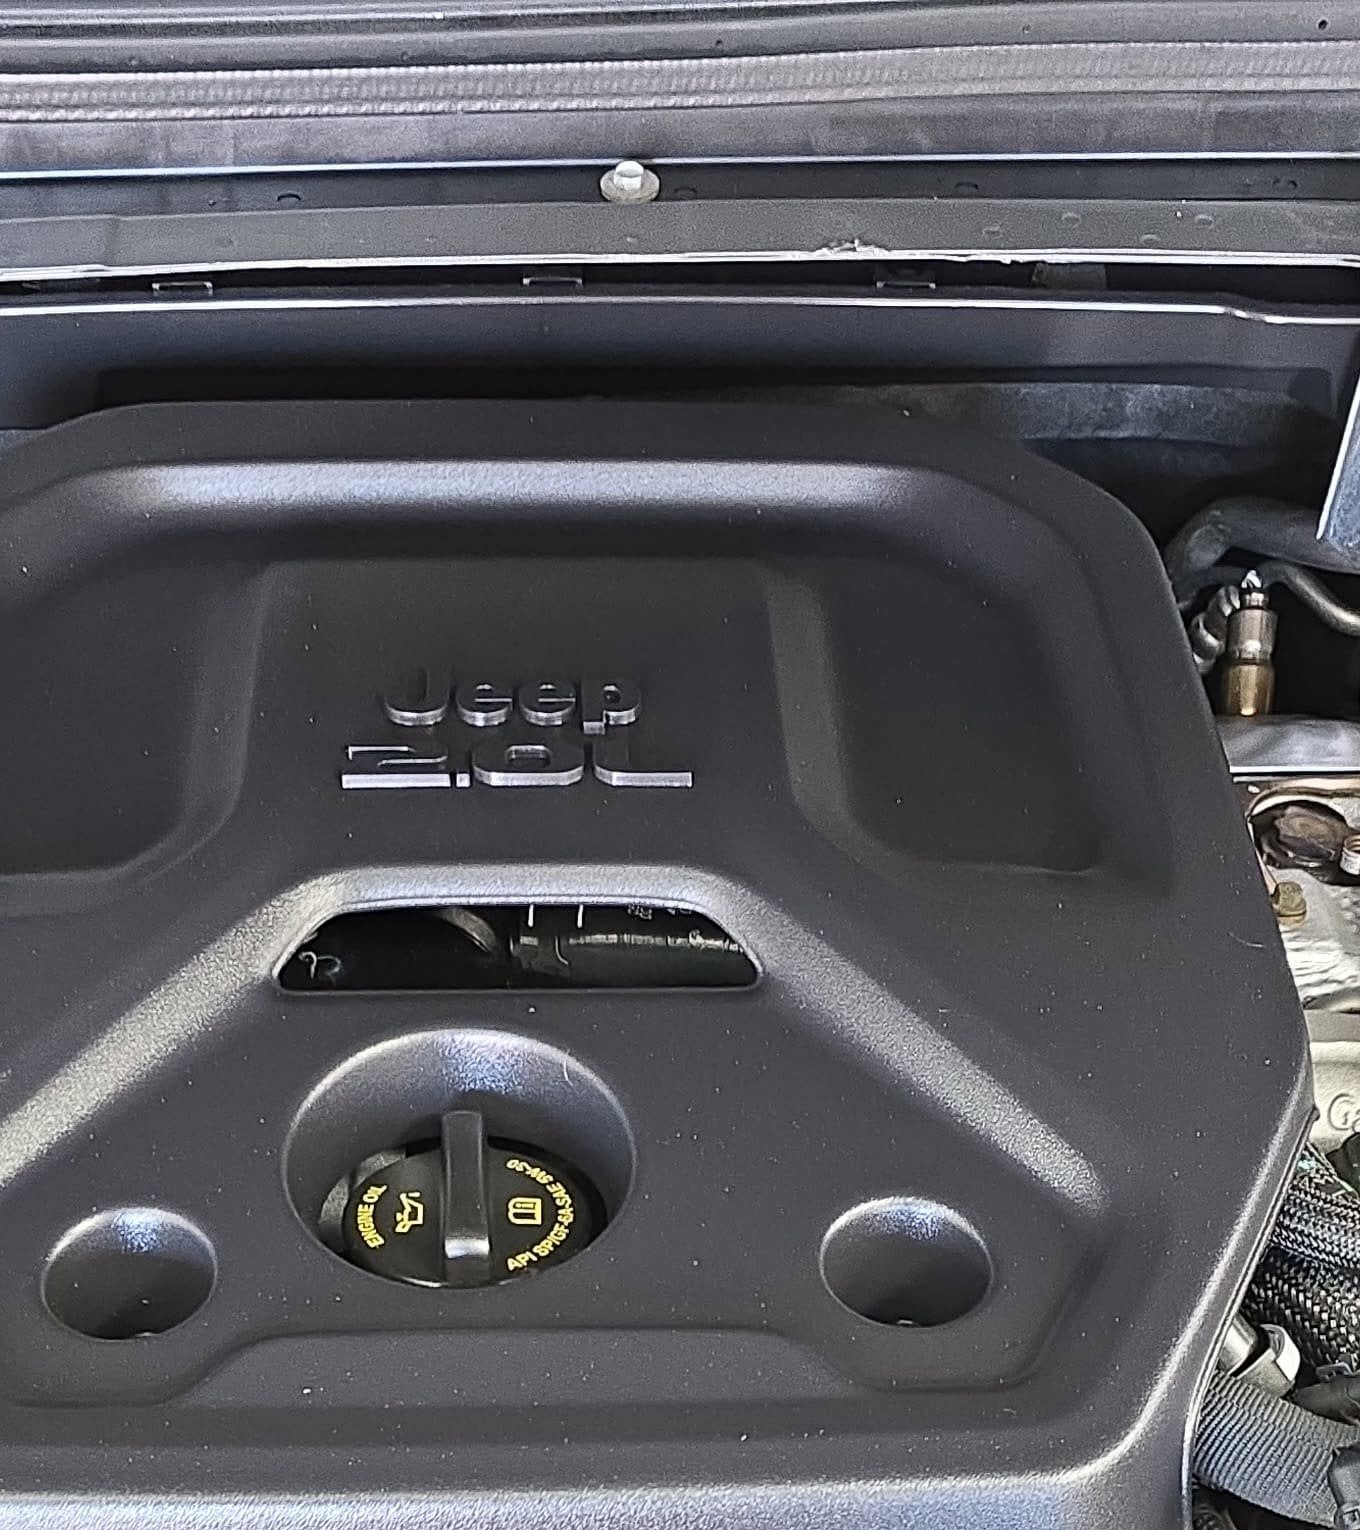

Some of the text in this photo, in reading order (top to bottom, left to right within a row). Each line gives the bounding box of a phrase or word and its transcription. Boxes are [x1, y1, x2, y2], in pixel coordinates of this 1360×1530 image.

[383, 668, 642, 735] Jeep
[342, 738, 694, 788] 2.0L
[356, 1184, 388, 1249] ENGINE OIL
